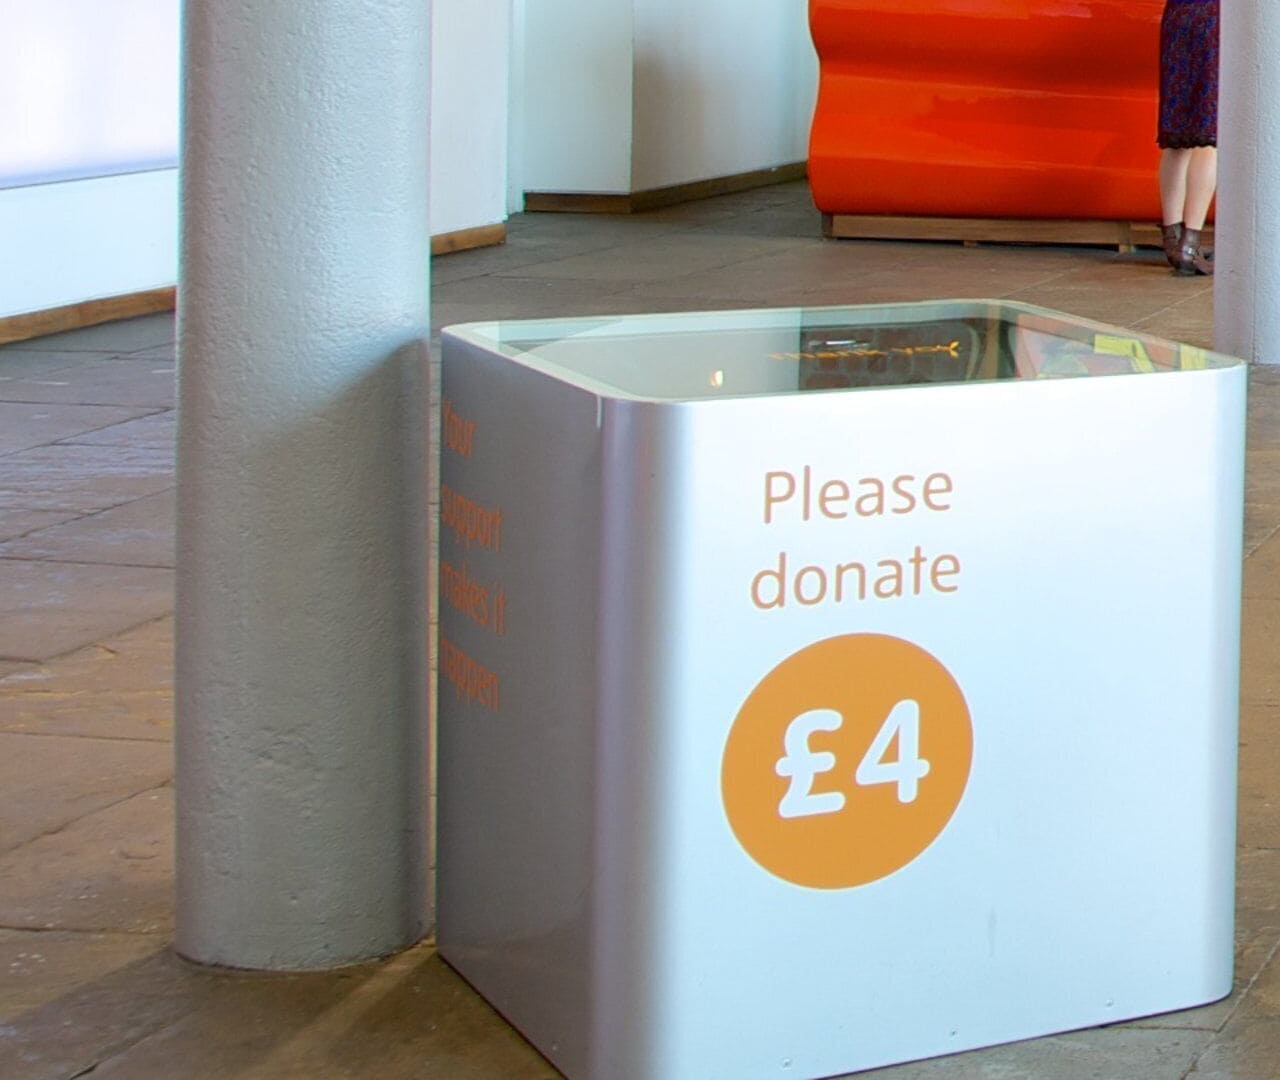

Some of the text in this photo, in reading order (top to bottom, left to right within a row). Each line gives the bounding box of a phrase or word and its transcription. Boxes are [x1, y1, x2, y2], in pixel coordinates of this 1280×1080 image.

[763, 464, 953, 524] Please
[751, 545, 961, 610] donate
[774, 698, 931, 819] £4
